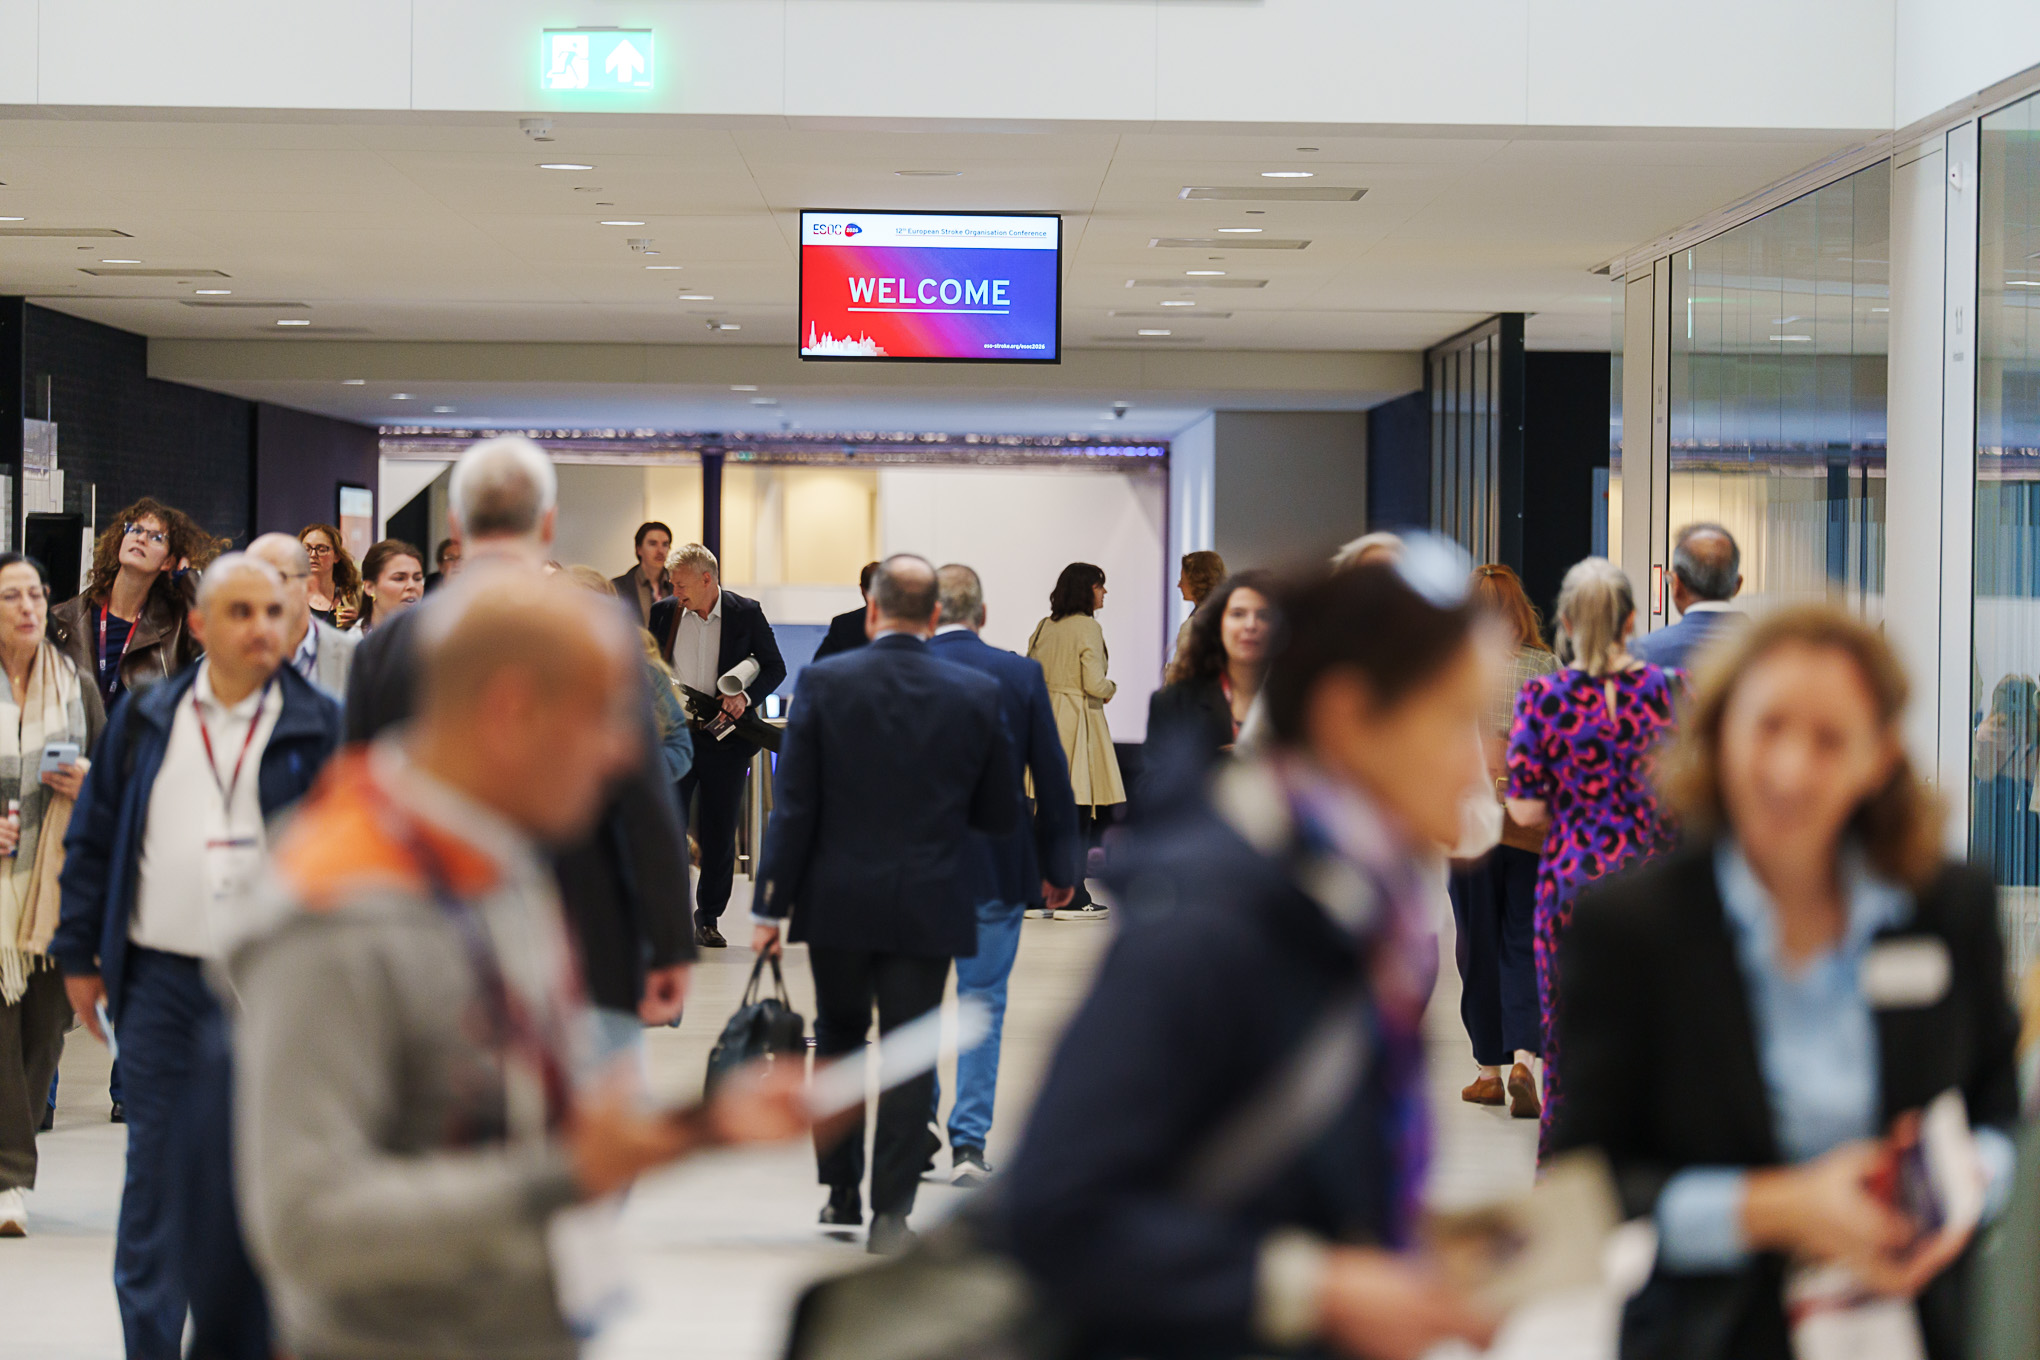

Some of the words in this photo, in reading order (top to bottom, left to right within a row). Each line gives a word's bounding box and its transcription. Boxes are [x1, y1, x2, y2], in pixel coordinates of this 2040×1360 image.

[813, 223, 842, 236] ESOC
[907, 228, 940, 236] European
[941, 228, 963, 236] Stroke
[964, 229, 1007, 237] Organisation
[1008, 229, 1047, 237] Conference
[848, 277, 1010, 305] WELCOME
